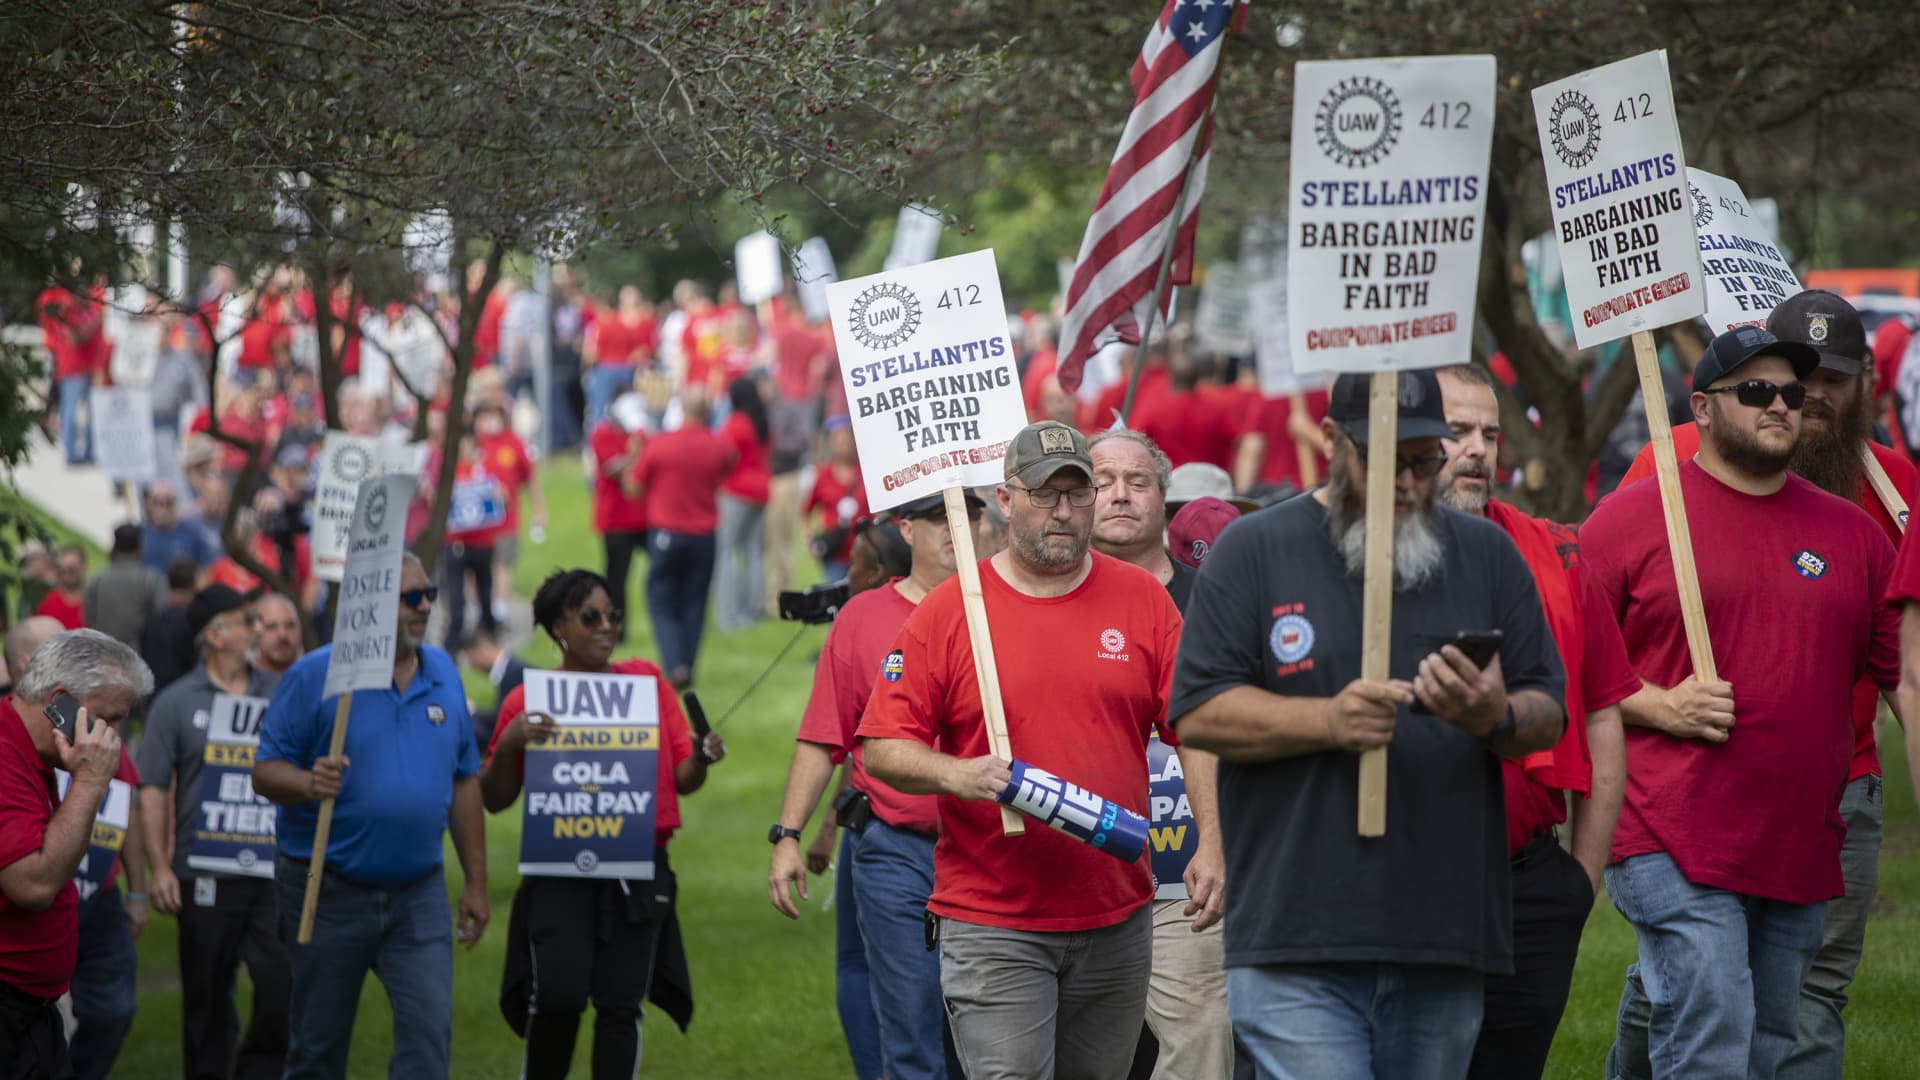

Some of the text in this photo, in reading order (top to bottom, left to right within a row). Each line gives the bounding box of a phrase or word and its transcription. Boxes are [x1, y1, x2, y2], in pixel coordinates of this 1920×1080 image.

[1339, 112, 1379, 132] UAW
[1419, 101, 1472, 129] 412
[1613, 93, 1653, 123] 412
[1562, 118, 1586, 141] UAW
[1301, 176, 1479, 207] STELLANTIS
[1555, 153, 1677, 209] STELLANTIS
[1561, 188, 1683, 243] BARGAINING
[1719, 196, 1749, 218] 412
[1300, 216, 1475, 248] BARGAINING
[1588, 223, 1660, 262] IN BAD
[1698, 234, 1783, 263] ELLANTIS
[1339, 250, 1437, 278] IN BAD
[1596, 250, 1662, 288] FAITH
[1703, 257, 1797, 286] ARGAINING
[936, 284, 982, 311] 412
[1344, 281, 1430, 310] FAITH
[1583, 272, 1691, 328] CORPORATE GREED
[1719, 275, 1787, 298] IN BAD
[868, 306, 901, 327] UAW
[1735, 294, 1784, 311] FAIT
[1307, 312, 1457, 351] CORPORATE GREED
[850, 337, 1006, 387] STELLANTIS
[856, 366, 1011, 417] BARGAINING
[895, 396, 981, 431] IN BAD
[904, 420, 981, 452] FAITH
[883, 448, 968, 491] CORPORATE
[1097, 650, 1129, 662] Local 412
[547, 678, 634, 718] UAW
[620, 730, 650, 746] UP
[215, 748, 249, 760] STA
[1148, 754, 1185, 783] LA
[552, 761, 630, 785] COLA
[528, 791, 652, 815] FAIR PAY
[1010, 766, 1064, 822] EN
[201, 800, 277, 836] TIER
[1048, 781, 1105, 843] TIE
[1151, 796, 1196, 823] PA
[553, 815, 624, 839] NOW
